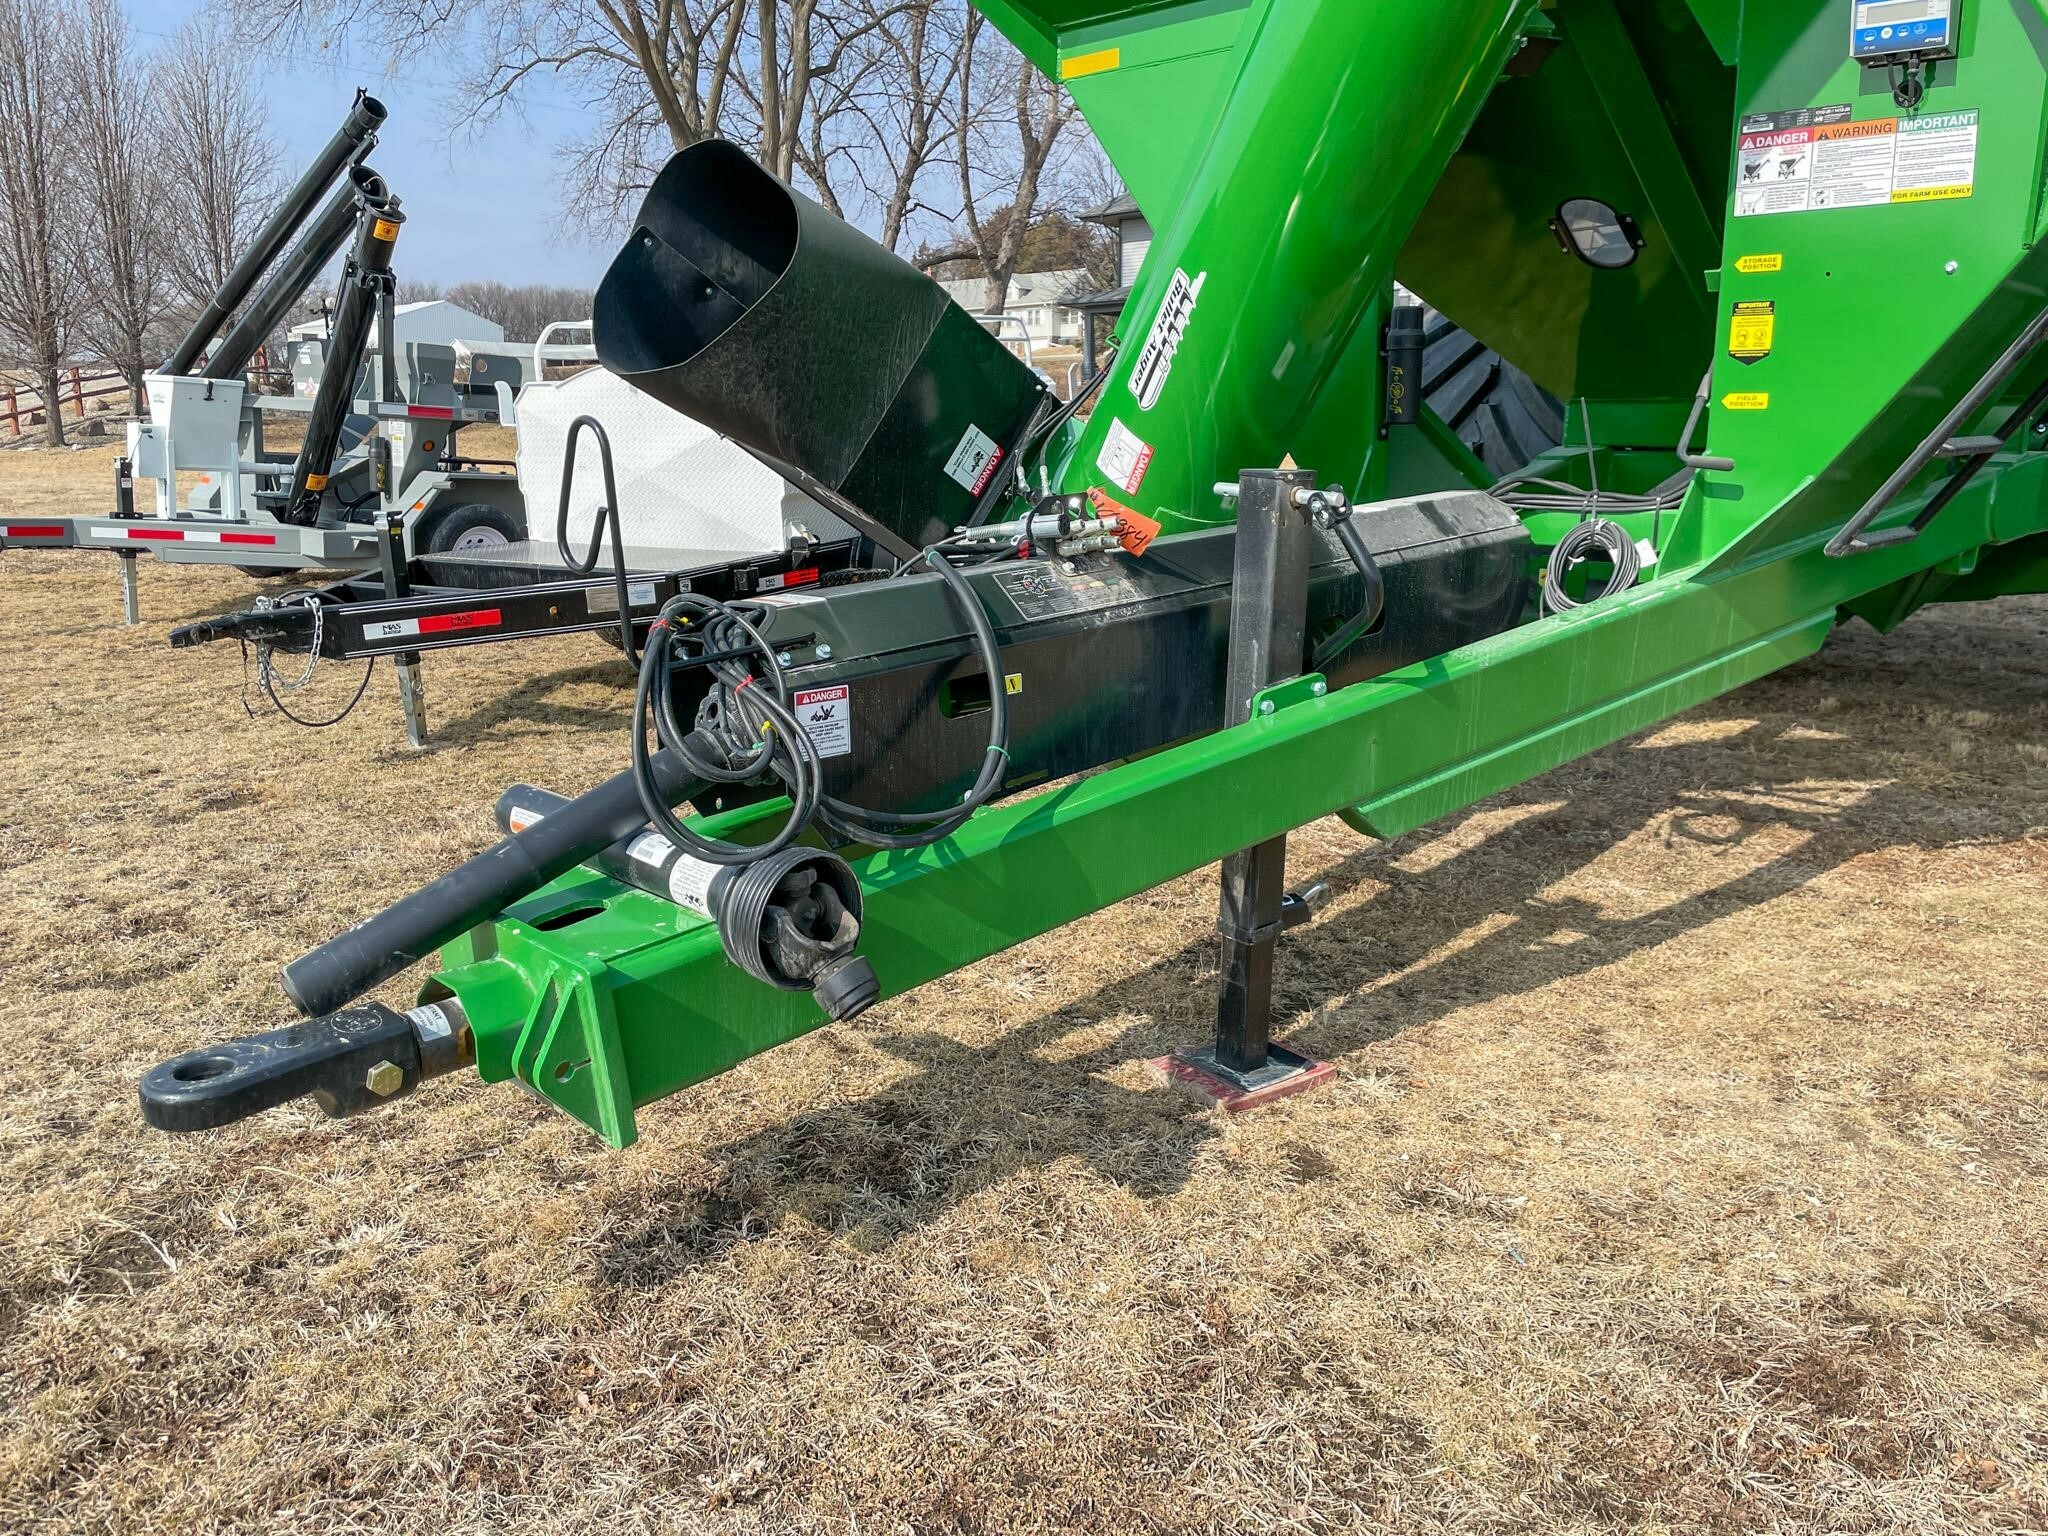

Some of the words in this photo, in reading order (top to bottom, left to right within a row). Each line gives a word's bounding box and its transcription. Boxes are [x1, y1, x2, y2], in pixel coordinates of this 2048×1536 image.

[1832, 122, 1893, 139] WARNING
[1899, 113, 1977, 131] IMPORTANT
[1755, 132, 1809, 147] DANGER
[1951, 187, 1971, 195] ONLY
[1743, 256, 1778, 264] STORAGE
[1157, 277, 1183, 334] Bullet
[1133, 336, 1159, 391] Auger
[1729, 400, 1764, 408] POSITION
[971, 458, 998, 494] DANGER
[1126, 454, 1149, 493] DANGER
[810, 689, 843, 702] DANGER
